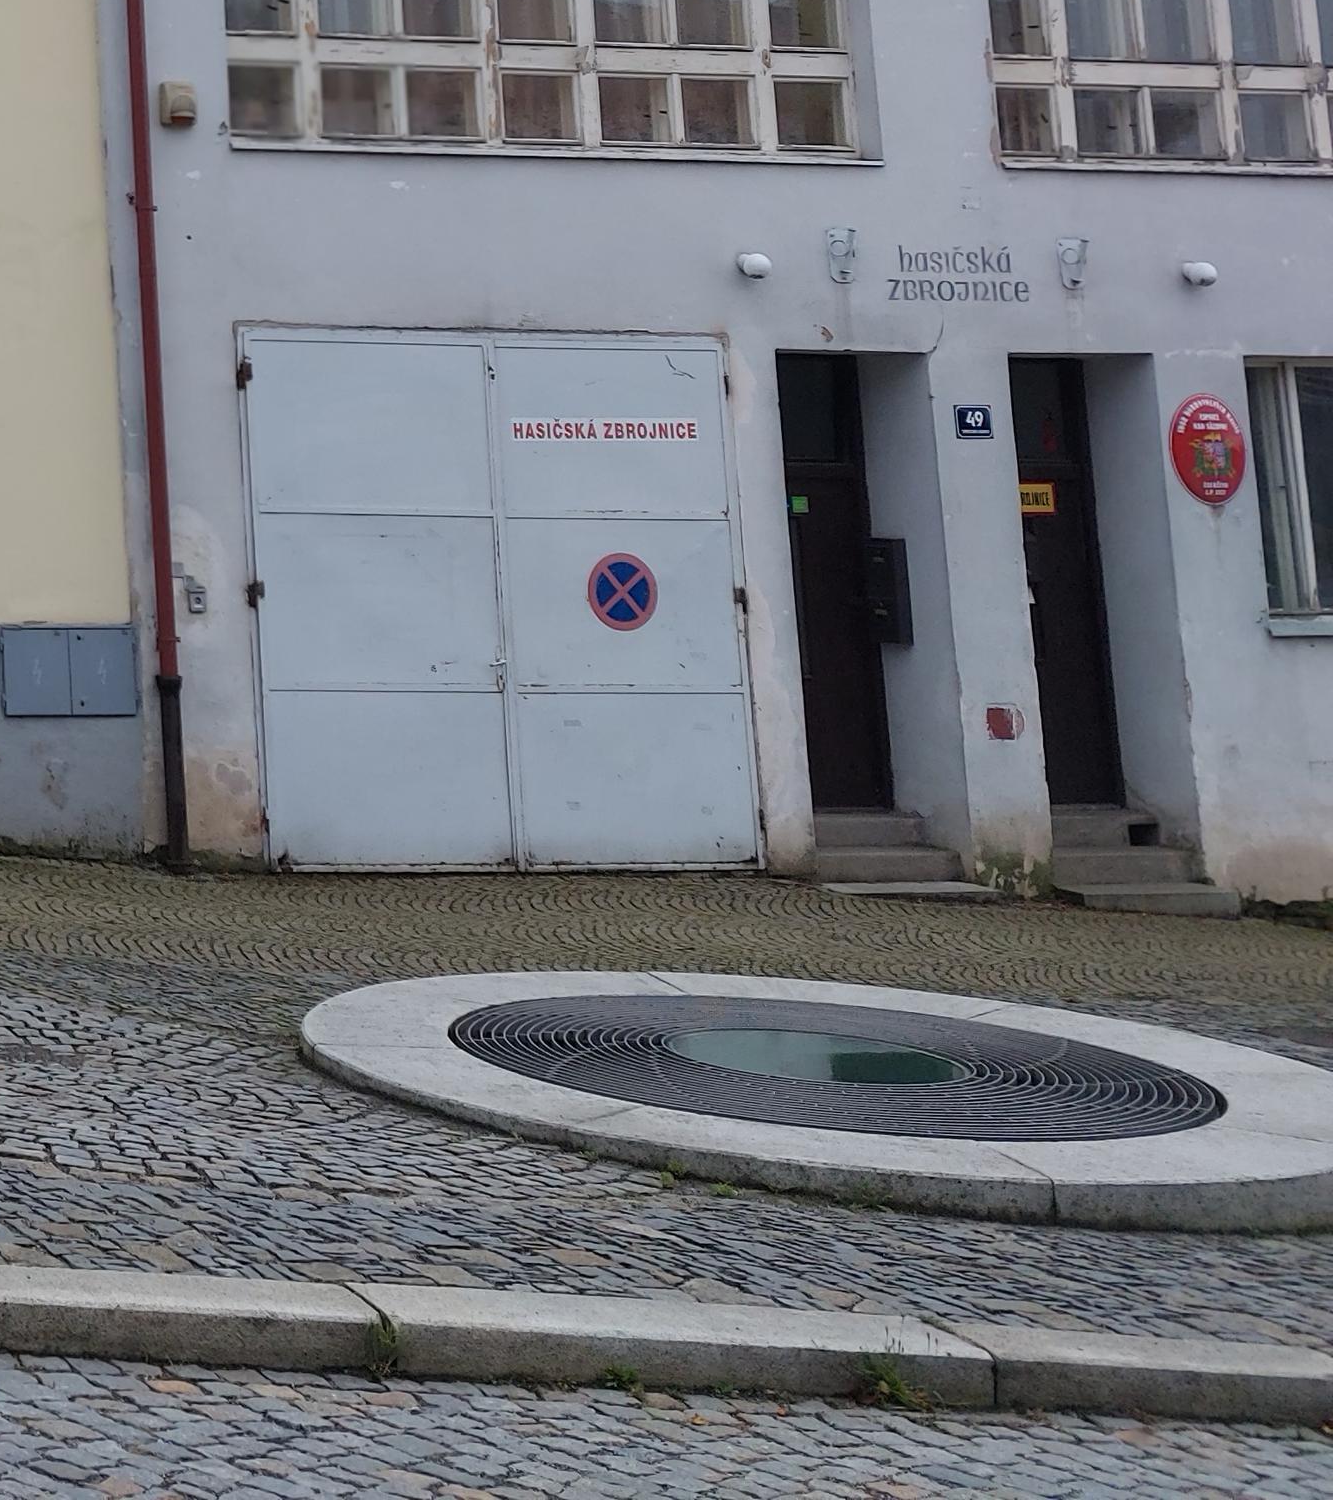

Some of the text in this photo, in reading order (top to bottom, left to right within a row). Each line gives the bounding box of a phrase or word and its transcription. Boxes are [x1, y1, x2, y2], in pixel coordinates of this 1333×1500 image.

[966, 411, 984, 427] 49
[513, 418, 697, 440] HASIČSKÁ ZBROJNICE
